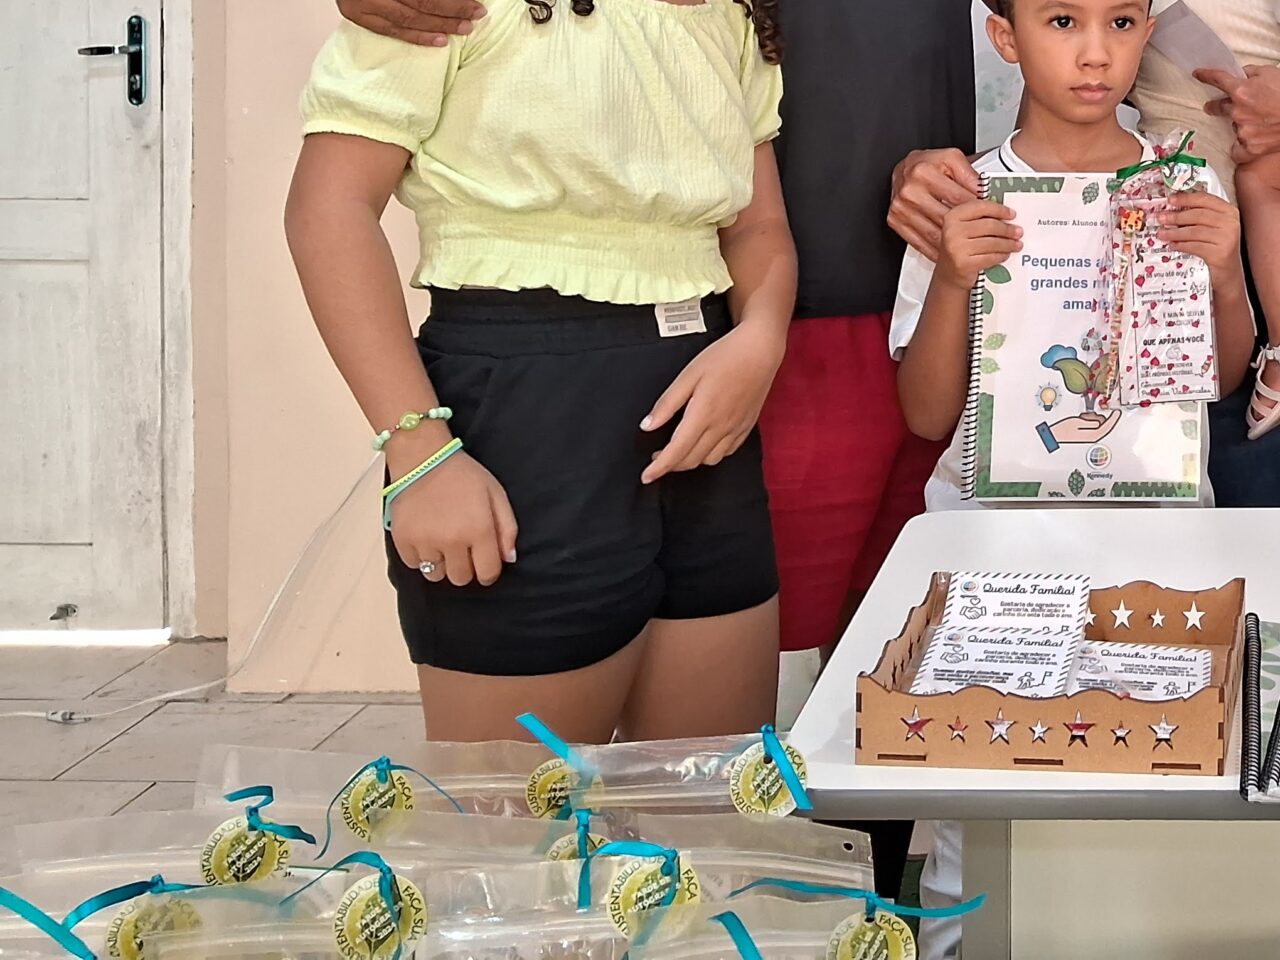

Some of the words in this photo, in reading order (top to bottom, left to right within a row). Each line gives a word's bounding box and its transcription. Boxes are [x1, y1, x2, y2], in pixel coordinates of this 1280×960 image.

[1021, 254, 1092, 270] Pequenas
[1030, 277, 1089, 291] grandes
[983, 583, 1028, 594] Querida
[968, 635, 1013, 645] Querida
[1101, 649, 1147, 659] Querida
[785, 745, 804, 770] FAÇA
[396, 775, 413, 802] FAÇA
[242, 855, 263, 873] 2024
[682, 868, 698, 900] FAÇA
[402, 886, 423, 915] FAÇA
[376, 921, 397, 939] 2024
[408, 918, 424, 941] SUA
[879, 915, 905, 937] FAÇA
